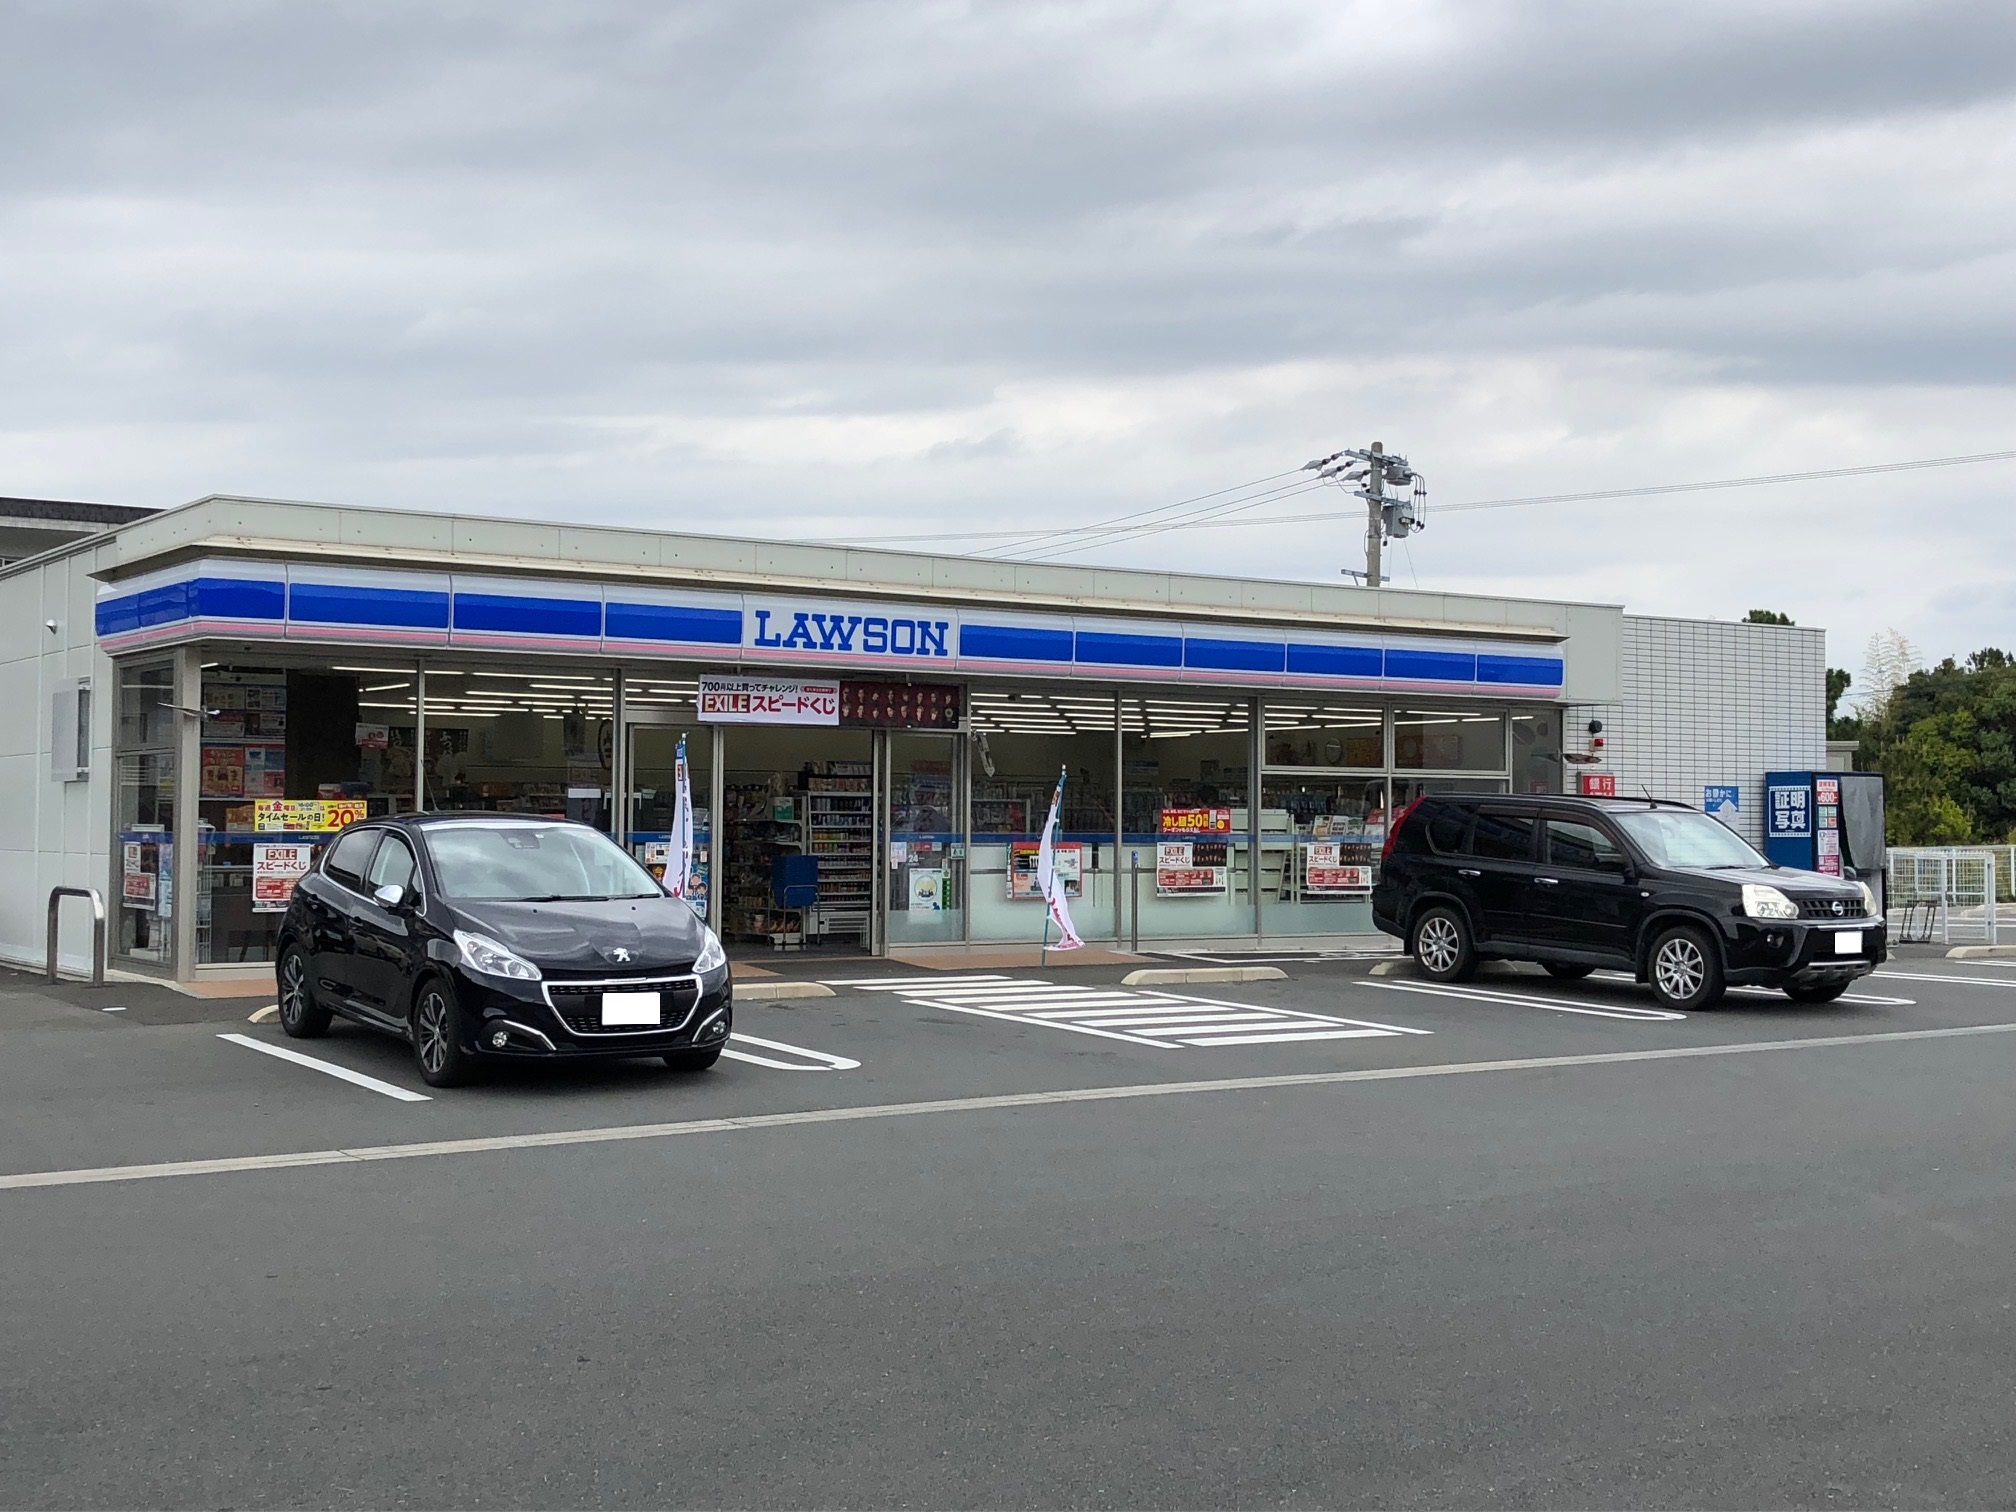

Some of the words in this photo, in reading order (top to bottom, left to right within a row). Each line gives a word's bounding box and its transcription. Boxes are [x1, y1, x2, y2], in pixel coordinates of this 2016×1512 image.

[755, 610, 949, 656] LAWSON
[704, 694, 748, 712] EXILE
[752, 695, 836, 715] スピードくじ
[1589, 777, 1612, 790] 銀行
[1774, 791, 1806, 809] 証明
[257, 812, 325, 822] タイムセールの日!
[327, 809, 365, 828] 20%
[1774, 810, 1806, 829] 写真
[267, 849, 296, 860] EXILE
[257, 861, 307, 871] スピードくじ
